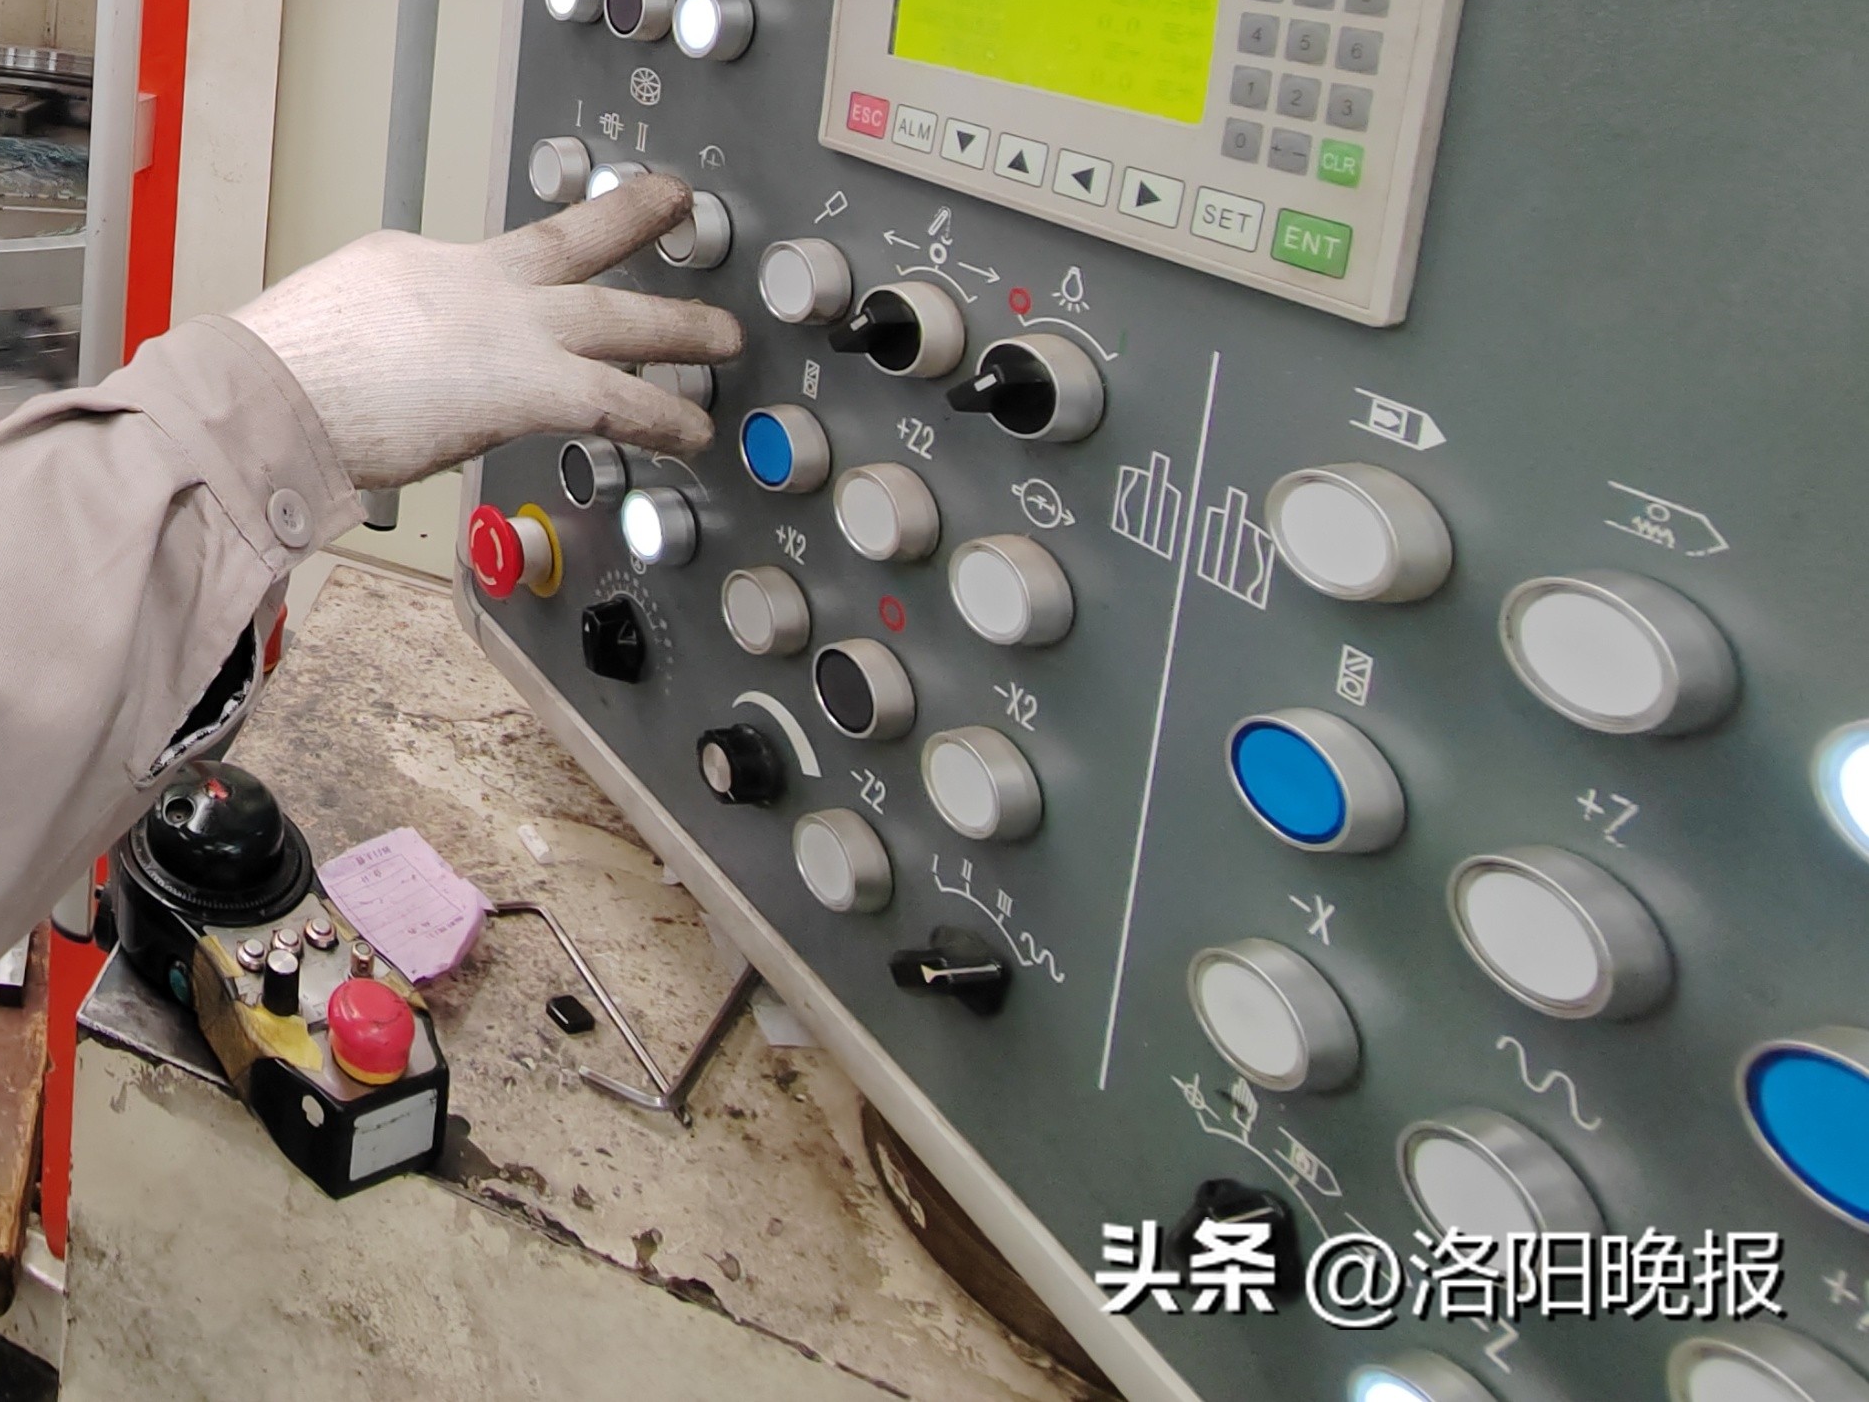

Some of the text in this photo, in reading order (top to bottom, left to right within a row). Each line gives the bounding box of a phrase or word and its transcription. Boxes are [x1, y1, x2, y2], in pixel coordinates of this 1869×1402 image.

[1251, 27, 1262, 42] 4
[1299, 34, 1311, 51] 5
[1350, 42, 1363, 60] 6
[1247, 81, 1255, 96] 1
[1290, 89, 1303, 107] 2
[852, 103, 883, 127] ESC
[1341, 99, 1353, 117] 3
[898, 118, 931, 141] ALM
[1234, 132, 1247, 149] 0
[1322, 152, 1356, 176] CLR
[1202, 203, 1253, 233] SET
[1283, 225, 1342, 260] ENT
[896, 417, 935, 460] +Z2
[775, 524, 807, 566] +X2
[993, 681, 1038, 732] -X2
[849, 768, 886, 815] -Z2
[1287, 894, 1336, 946] -X
